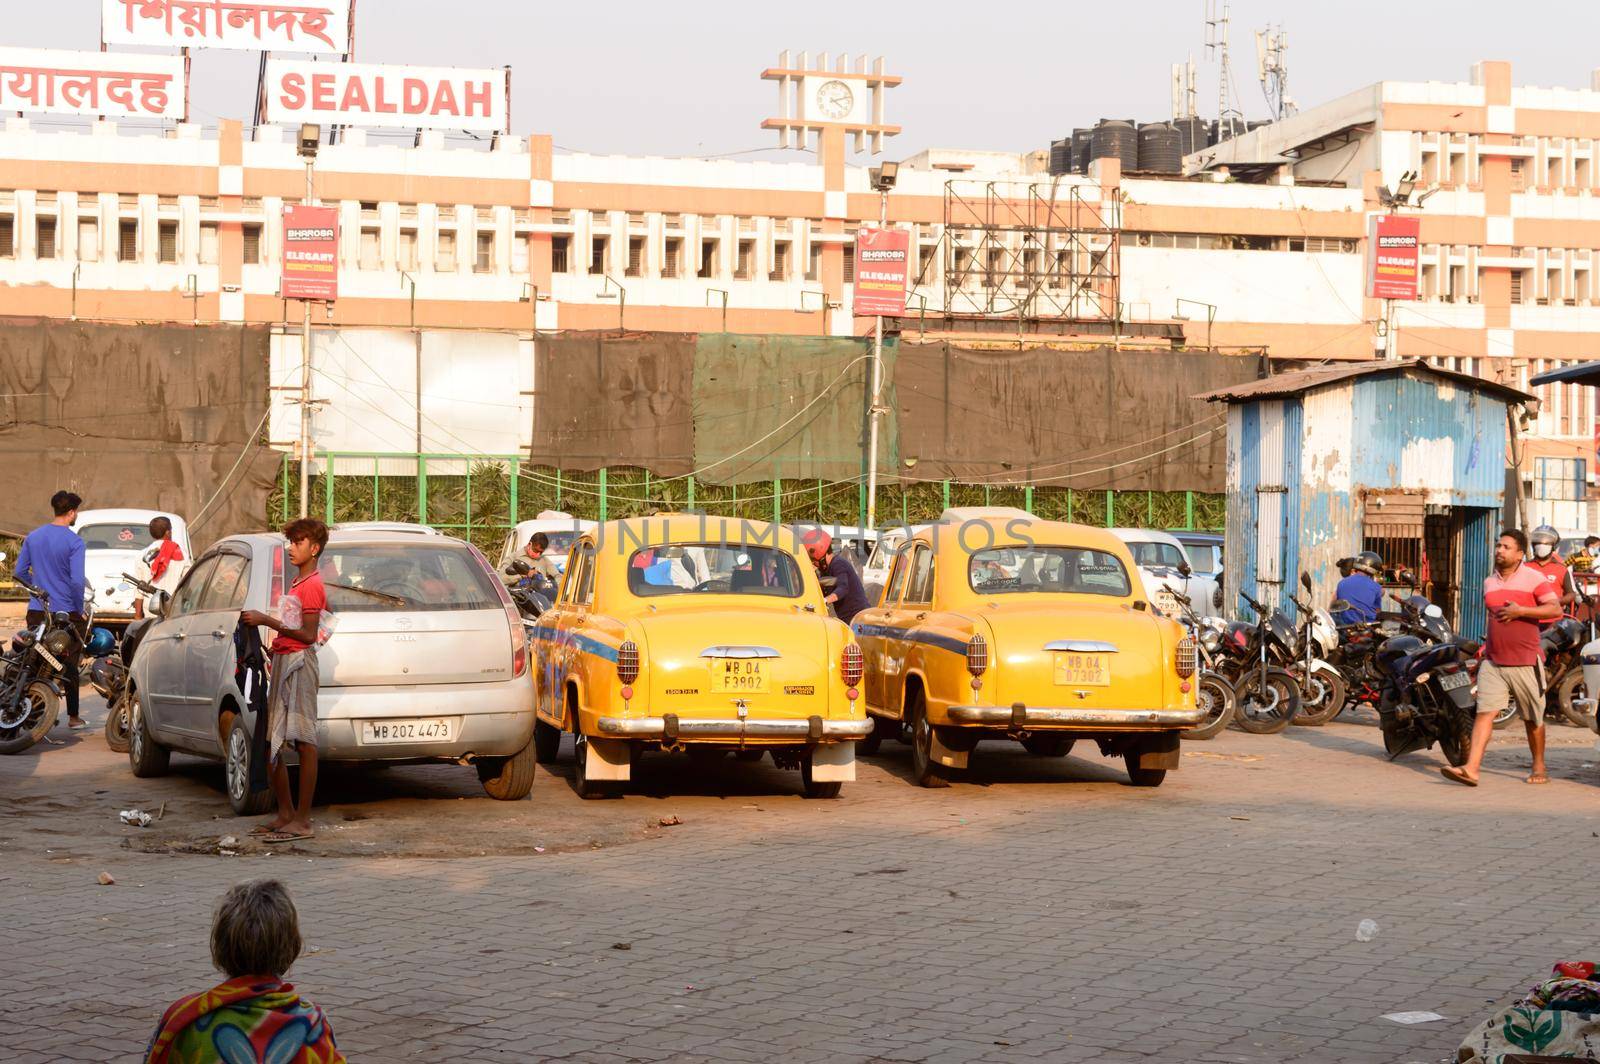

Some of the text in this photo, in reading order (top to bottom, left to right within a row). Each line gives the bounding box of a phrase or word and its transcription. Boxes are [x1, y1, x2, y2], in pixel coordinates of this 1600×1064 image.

[0, 66, 173, 114] यालदह
[280, 73, 492, 117] SEALDAH
[726, 662, 760, 674] WB 04
[1068, 656, 1099, 668] WB 04
[373, 725, 388, 738] WB
[418, 723, 448, 737] 4473
